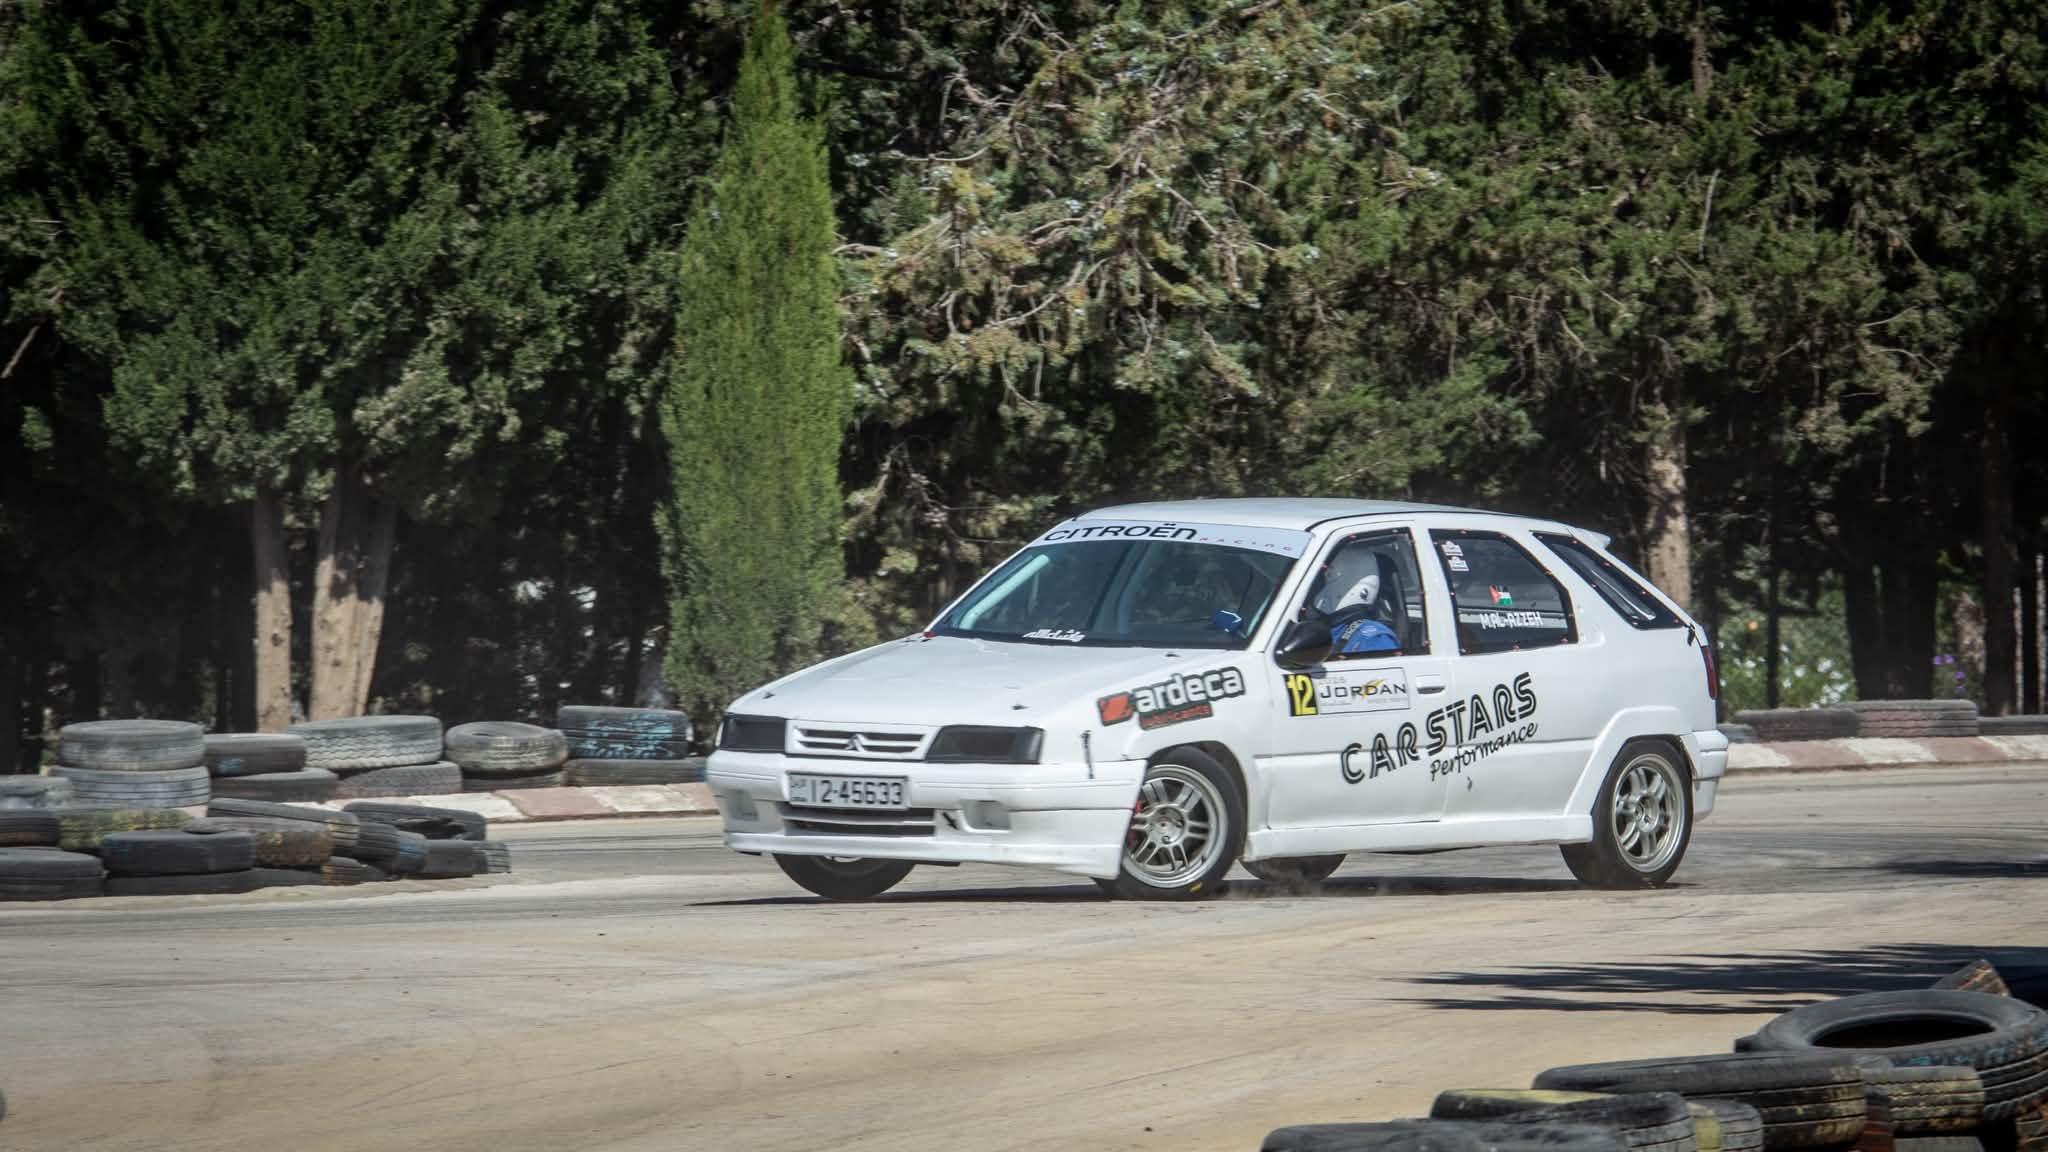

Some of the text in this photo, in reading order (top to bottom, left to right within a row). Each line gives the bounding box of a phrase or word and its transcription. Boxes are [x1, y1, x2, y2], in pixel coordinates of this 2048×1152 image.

[1134, 669, 1245, 713] ardeca
[1286, 674, 1317, 715] 12
[1320, 684, 1406, 698] JORDAN
[1430, 722, 1538, 781] Performance
[810, 779, 902, 805] 12-45633
